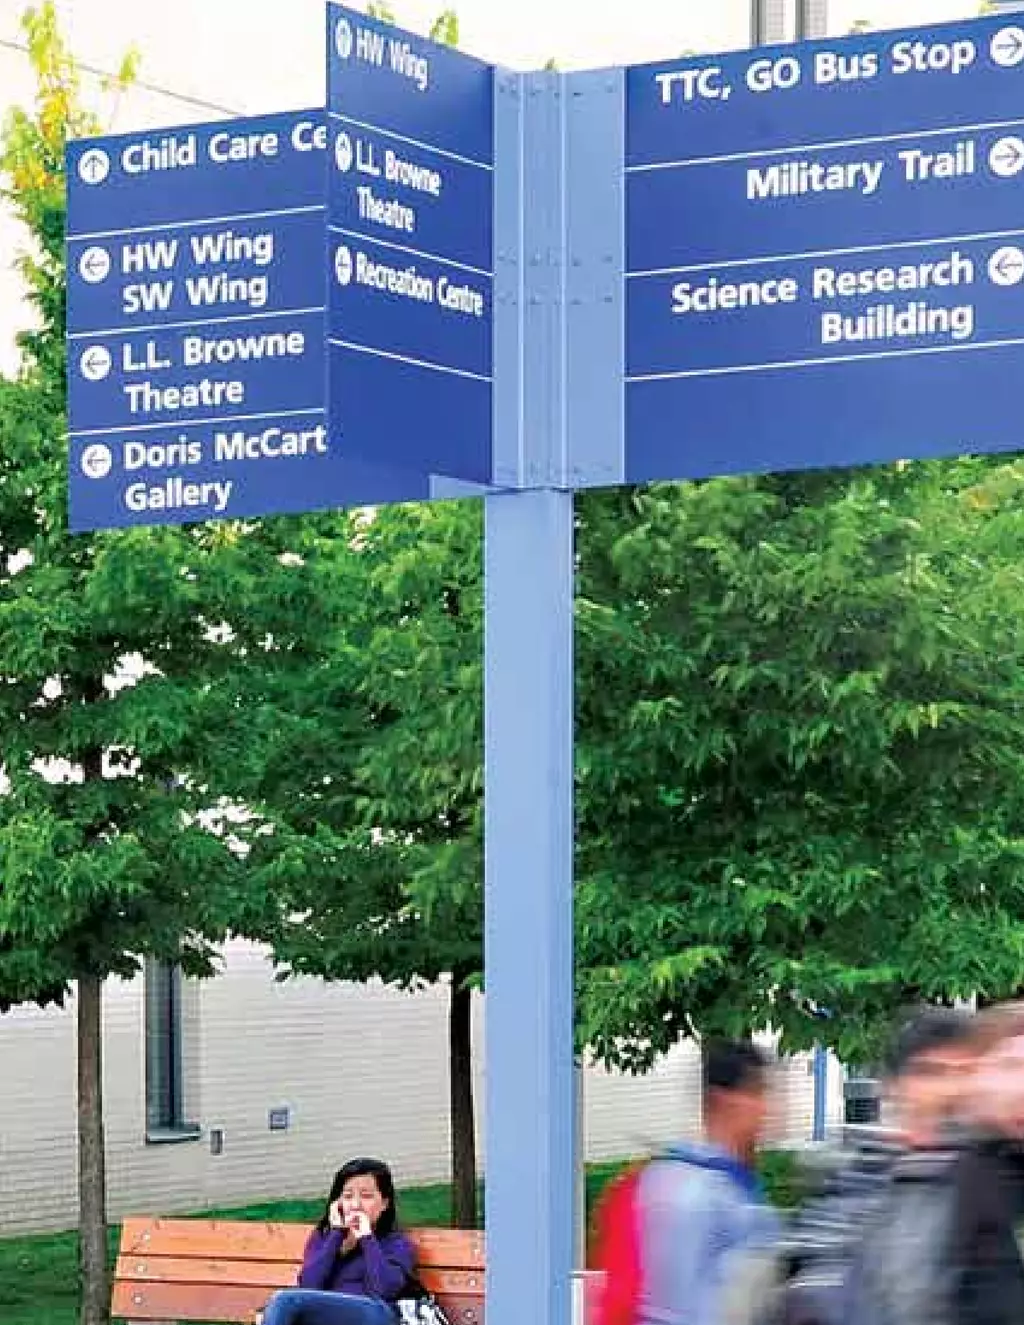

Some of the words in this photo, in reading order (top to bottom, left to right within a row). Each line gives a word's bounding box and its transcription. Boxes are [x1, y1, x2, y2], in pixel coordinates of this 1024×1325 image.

[356, 27, 385, 67] HW
[388, 38, 428, 91] Wing
[655, 68, 731, 103] TTC,
[746, 56, 801, 92] GO
[814, 51, 878, 85] Bus
[891, 40, 976, 74] Stop
[122, 135, 197, 173] Child
[207, 133, 278, 163] Care
[385, 150, 441, 197] Browne
[746, 161, 885, 200] Military
[898, 140, 975, 181] Trail
[356, 186, 414, 232] Theatre
[122, 239, 178, 274] HW
[190, 231, 274, 266] Wing
[123, 280, 173, 313] SW
[185, 272, 269, 308] Wing
[356, 251, 433, 303] Recreation
[436, 276, 484, 317] Centre
[671, 277, 799, 313] Science
[813, 251, 974, 299] Research
[122, 340, 171, 371] L.L.
[183, 330, 305, 366] Browne
[123, 378, 245, 414] Theatre
[123, 434, 202, 470] Doris
[125, 477, 233, 512] Gallery
